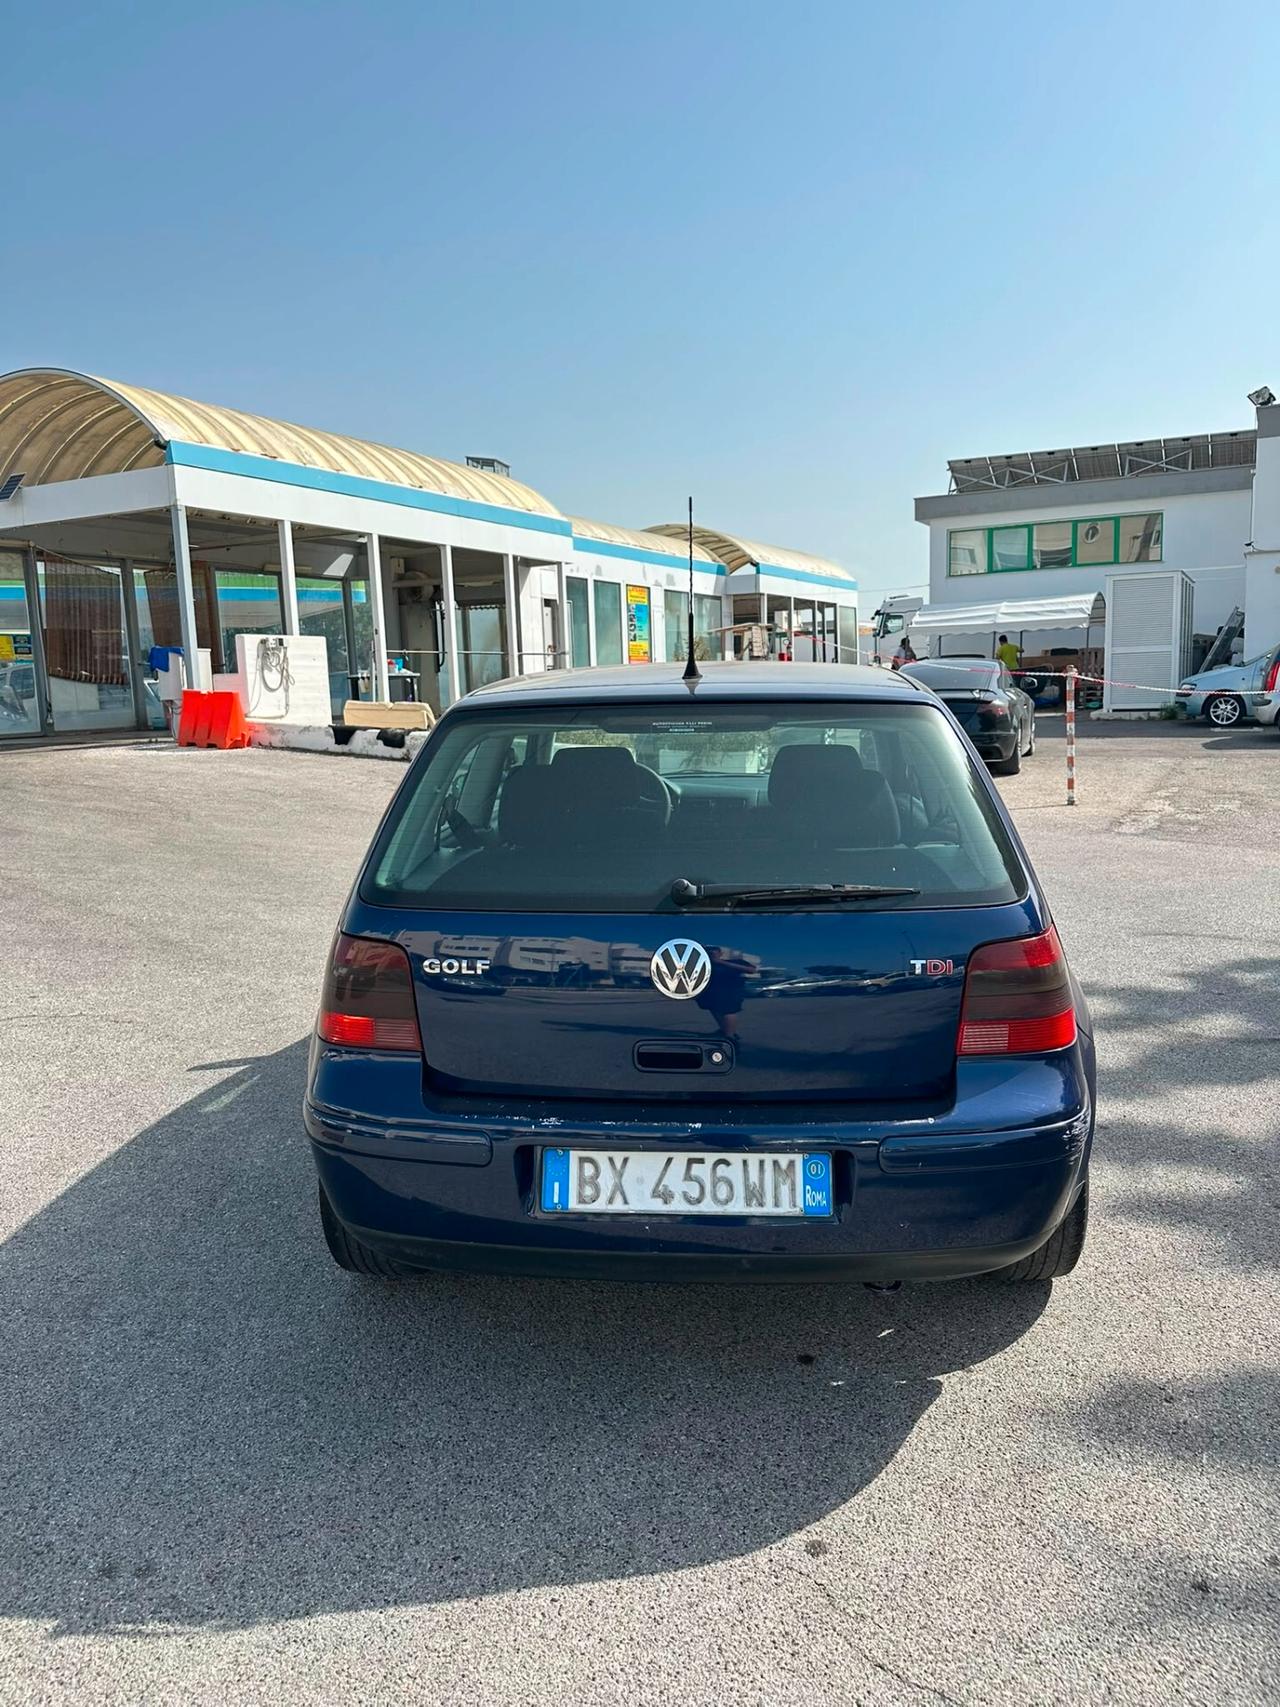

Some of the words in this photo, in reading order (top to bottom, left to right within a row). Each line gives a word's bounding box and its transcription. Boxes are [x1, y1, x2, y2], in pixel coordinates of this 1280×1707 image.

[422, 958, 491, 975] GOLF
[652, 939, 711, 999] VW
[910, 959, 953, 975] TDI
[553, 1181, 560, 1204] I
[576, 1156, 629, 1205] BX
[651, 1156, 797, 1208] 456WM
